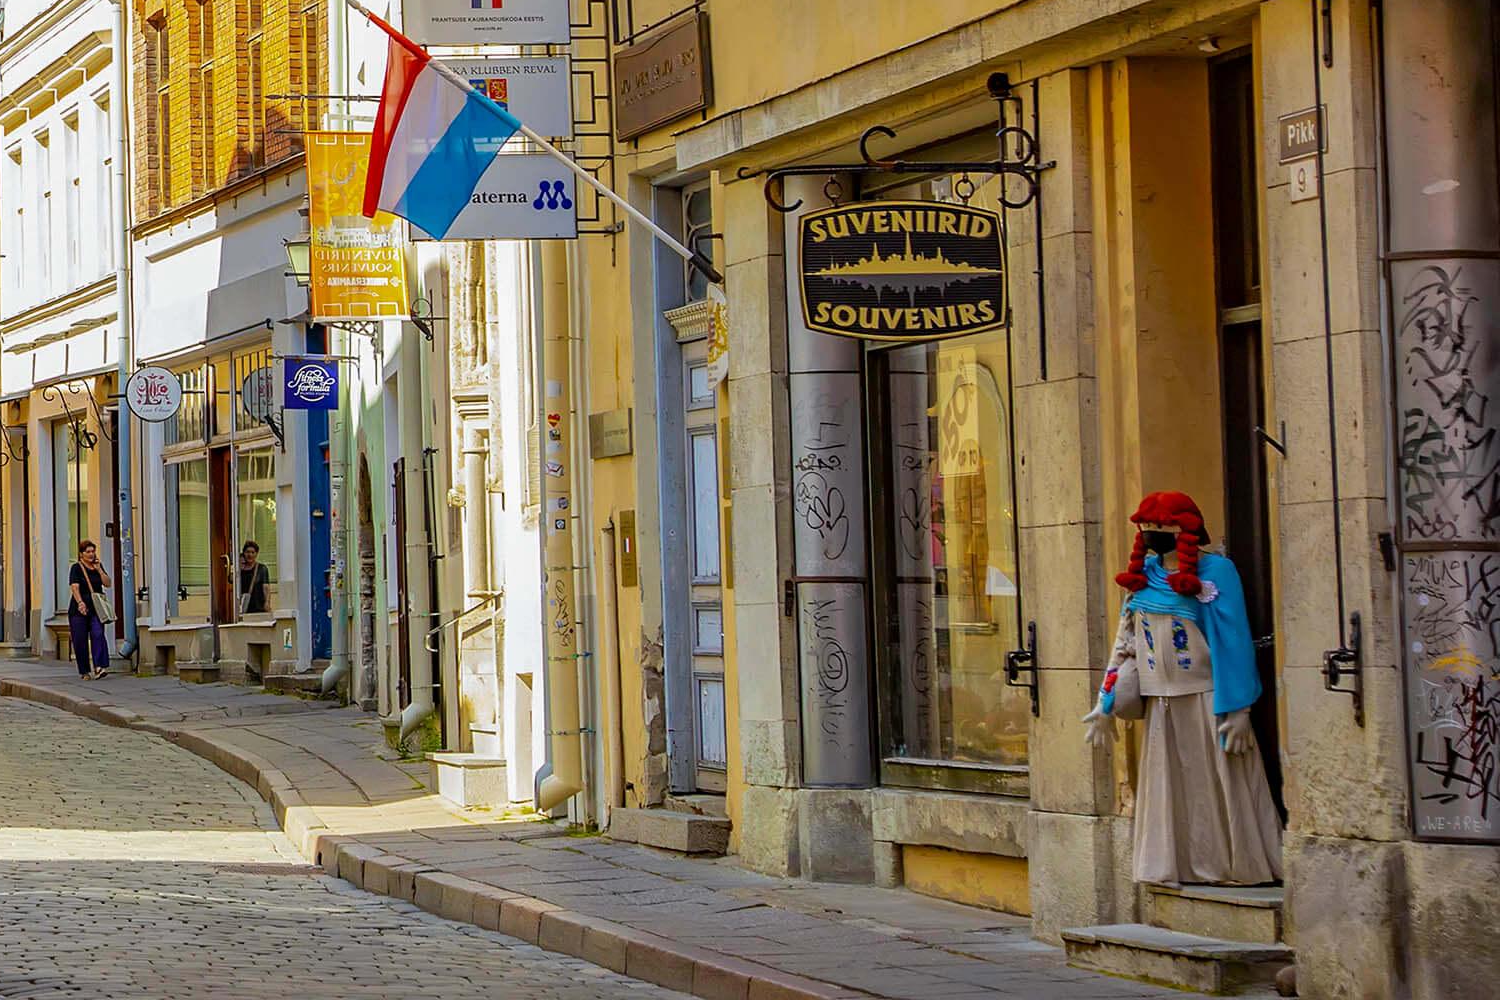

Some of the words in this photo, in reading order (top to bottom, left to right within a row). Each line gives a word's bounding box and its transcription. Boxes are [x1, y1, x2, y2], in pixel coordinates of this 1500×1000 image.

[470, 65, 520, 75] KLUBBEN
[523, 64, 557, 74] REVAL
[1287, 119, 1316, 148] Pikk
[1297, 167, 1307, 193] 9
[809, 210, 993, 243] SUVENIIRID
[813, 299, 996, 330] SOUVENIRS
